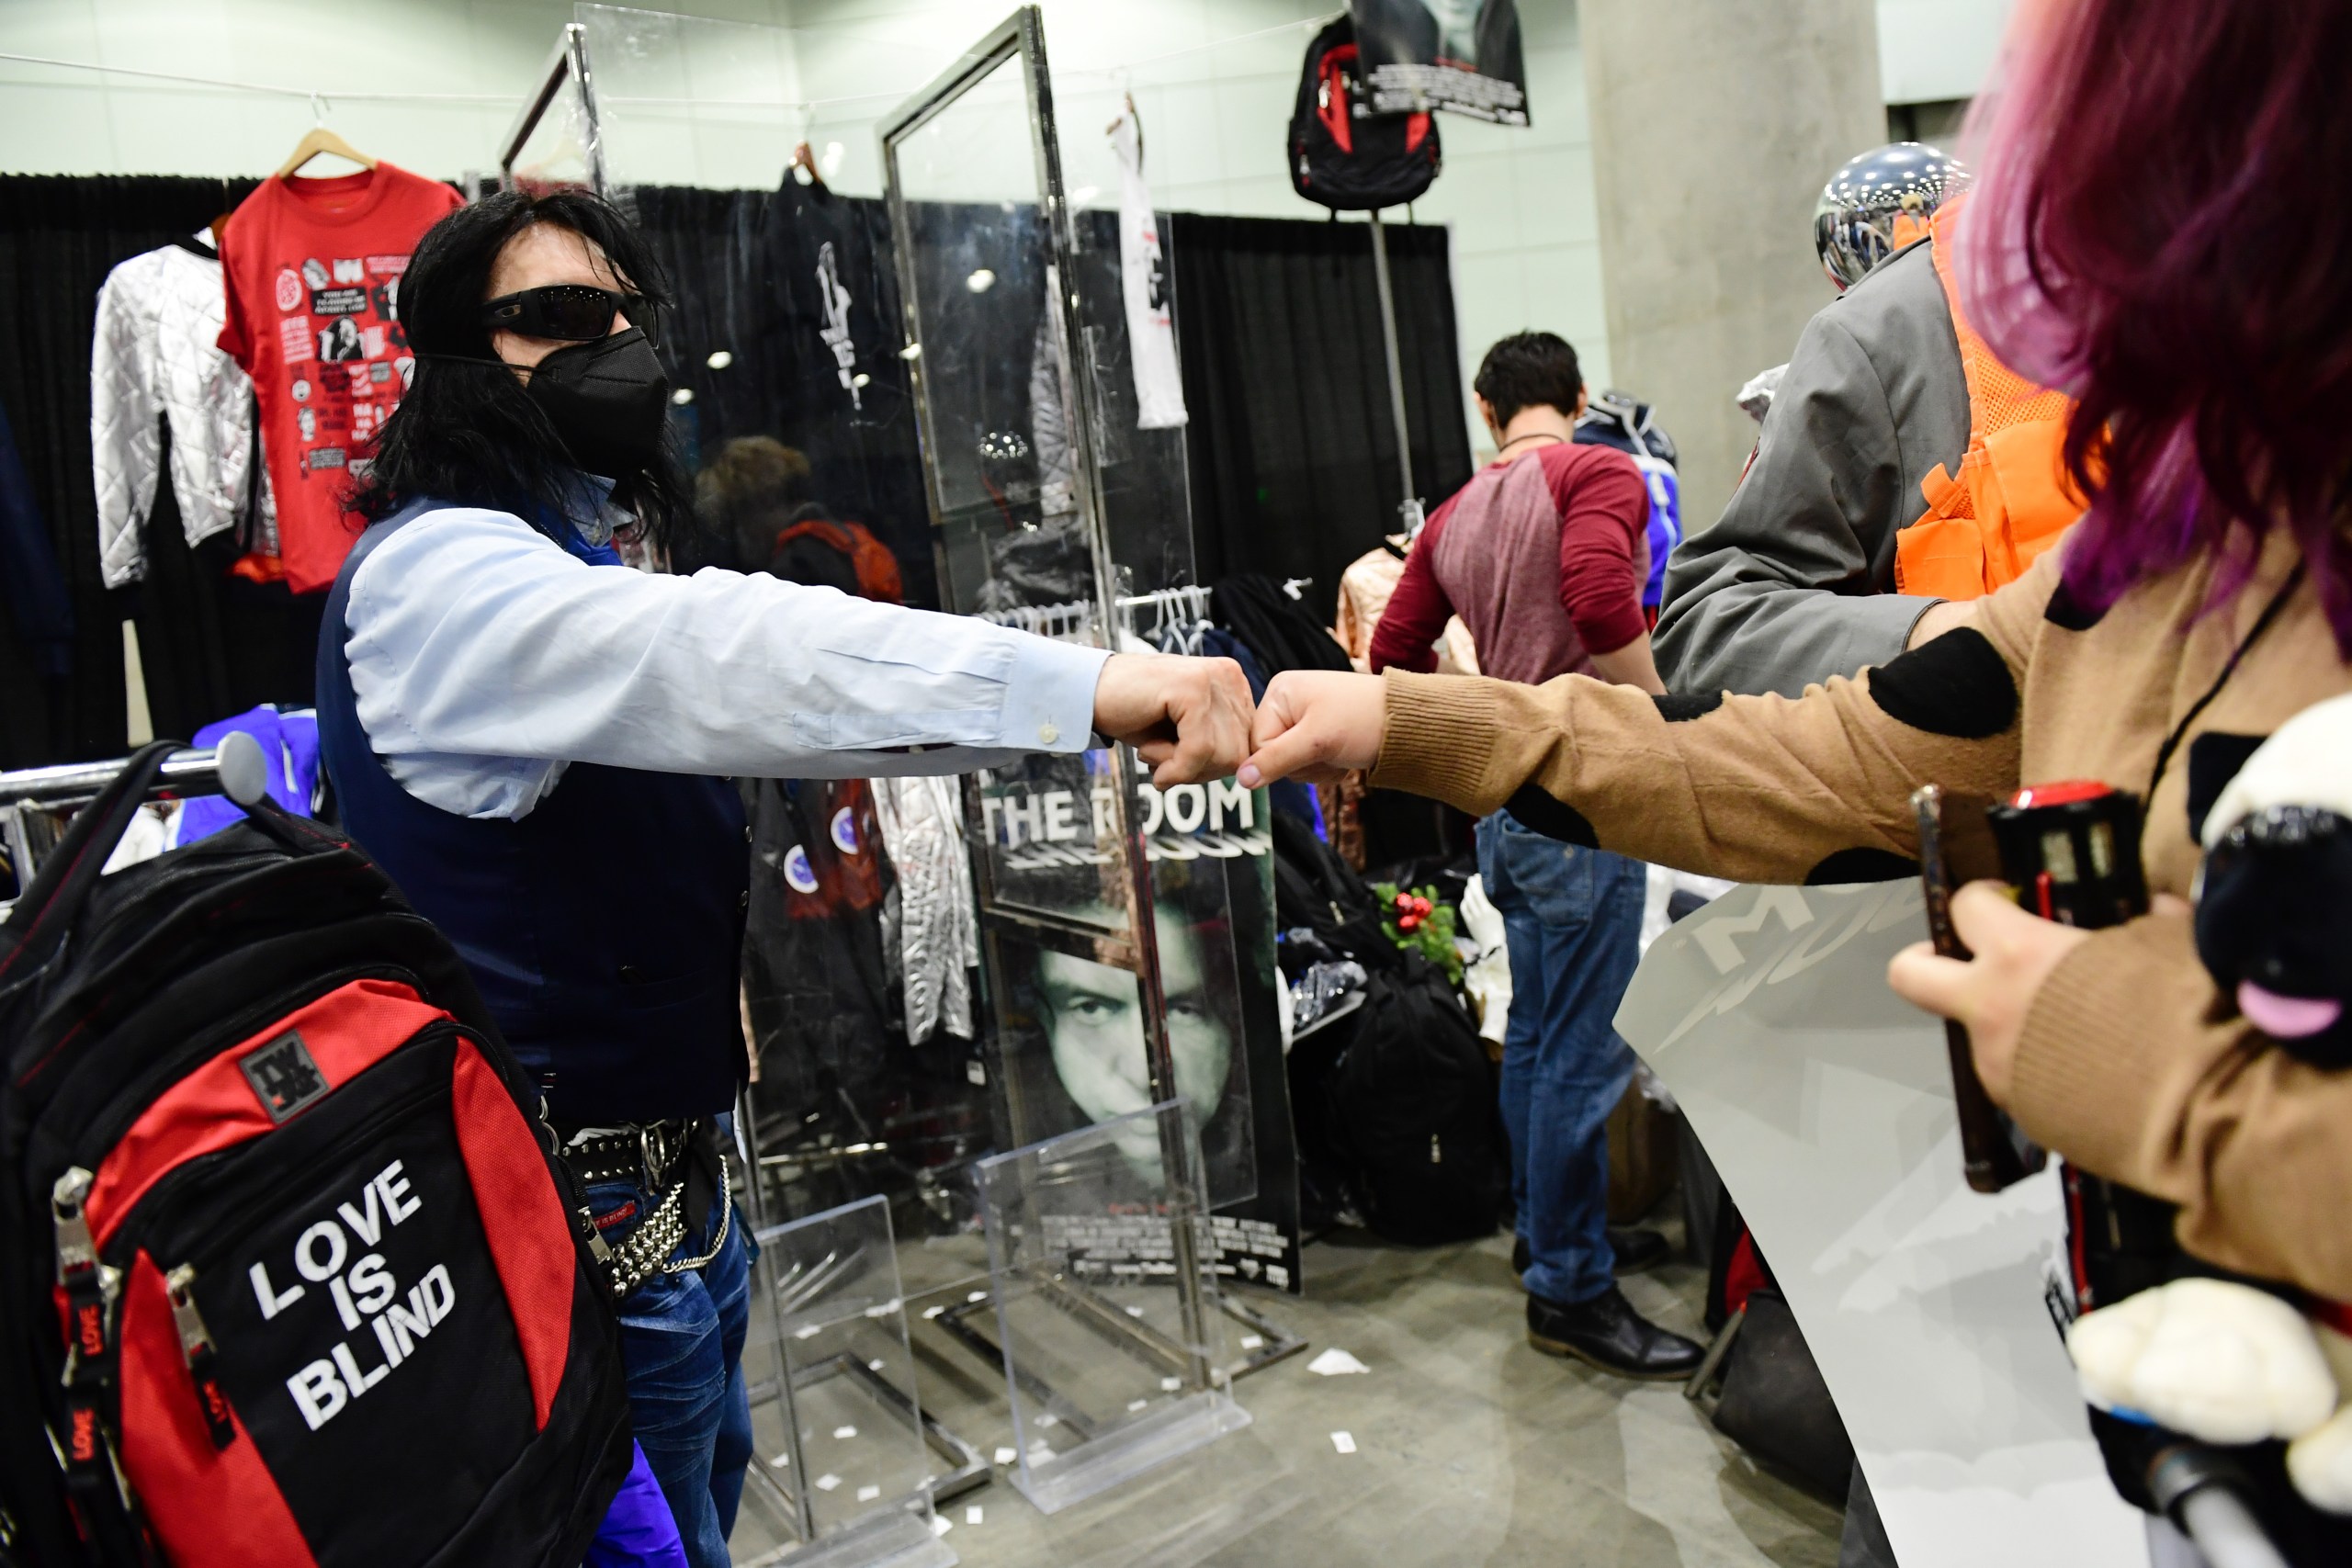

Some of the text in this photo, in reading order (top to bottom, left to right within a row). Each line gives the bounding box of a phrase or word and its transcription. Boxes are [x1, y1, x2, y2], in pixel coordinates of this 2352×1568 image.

[981, 790, 1078, 850] THE
[249, 1159, 423, 1320] LOVE
[329, 1253, 397, 1332] IS
[79, 1304, 103, 1356] LOVE
[286, 1263, 456, 1431] BLIND
[73, 1408, 95, 1461] LOVE
